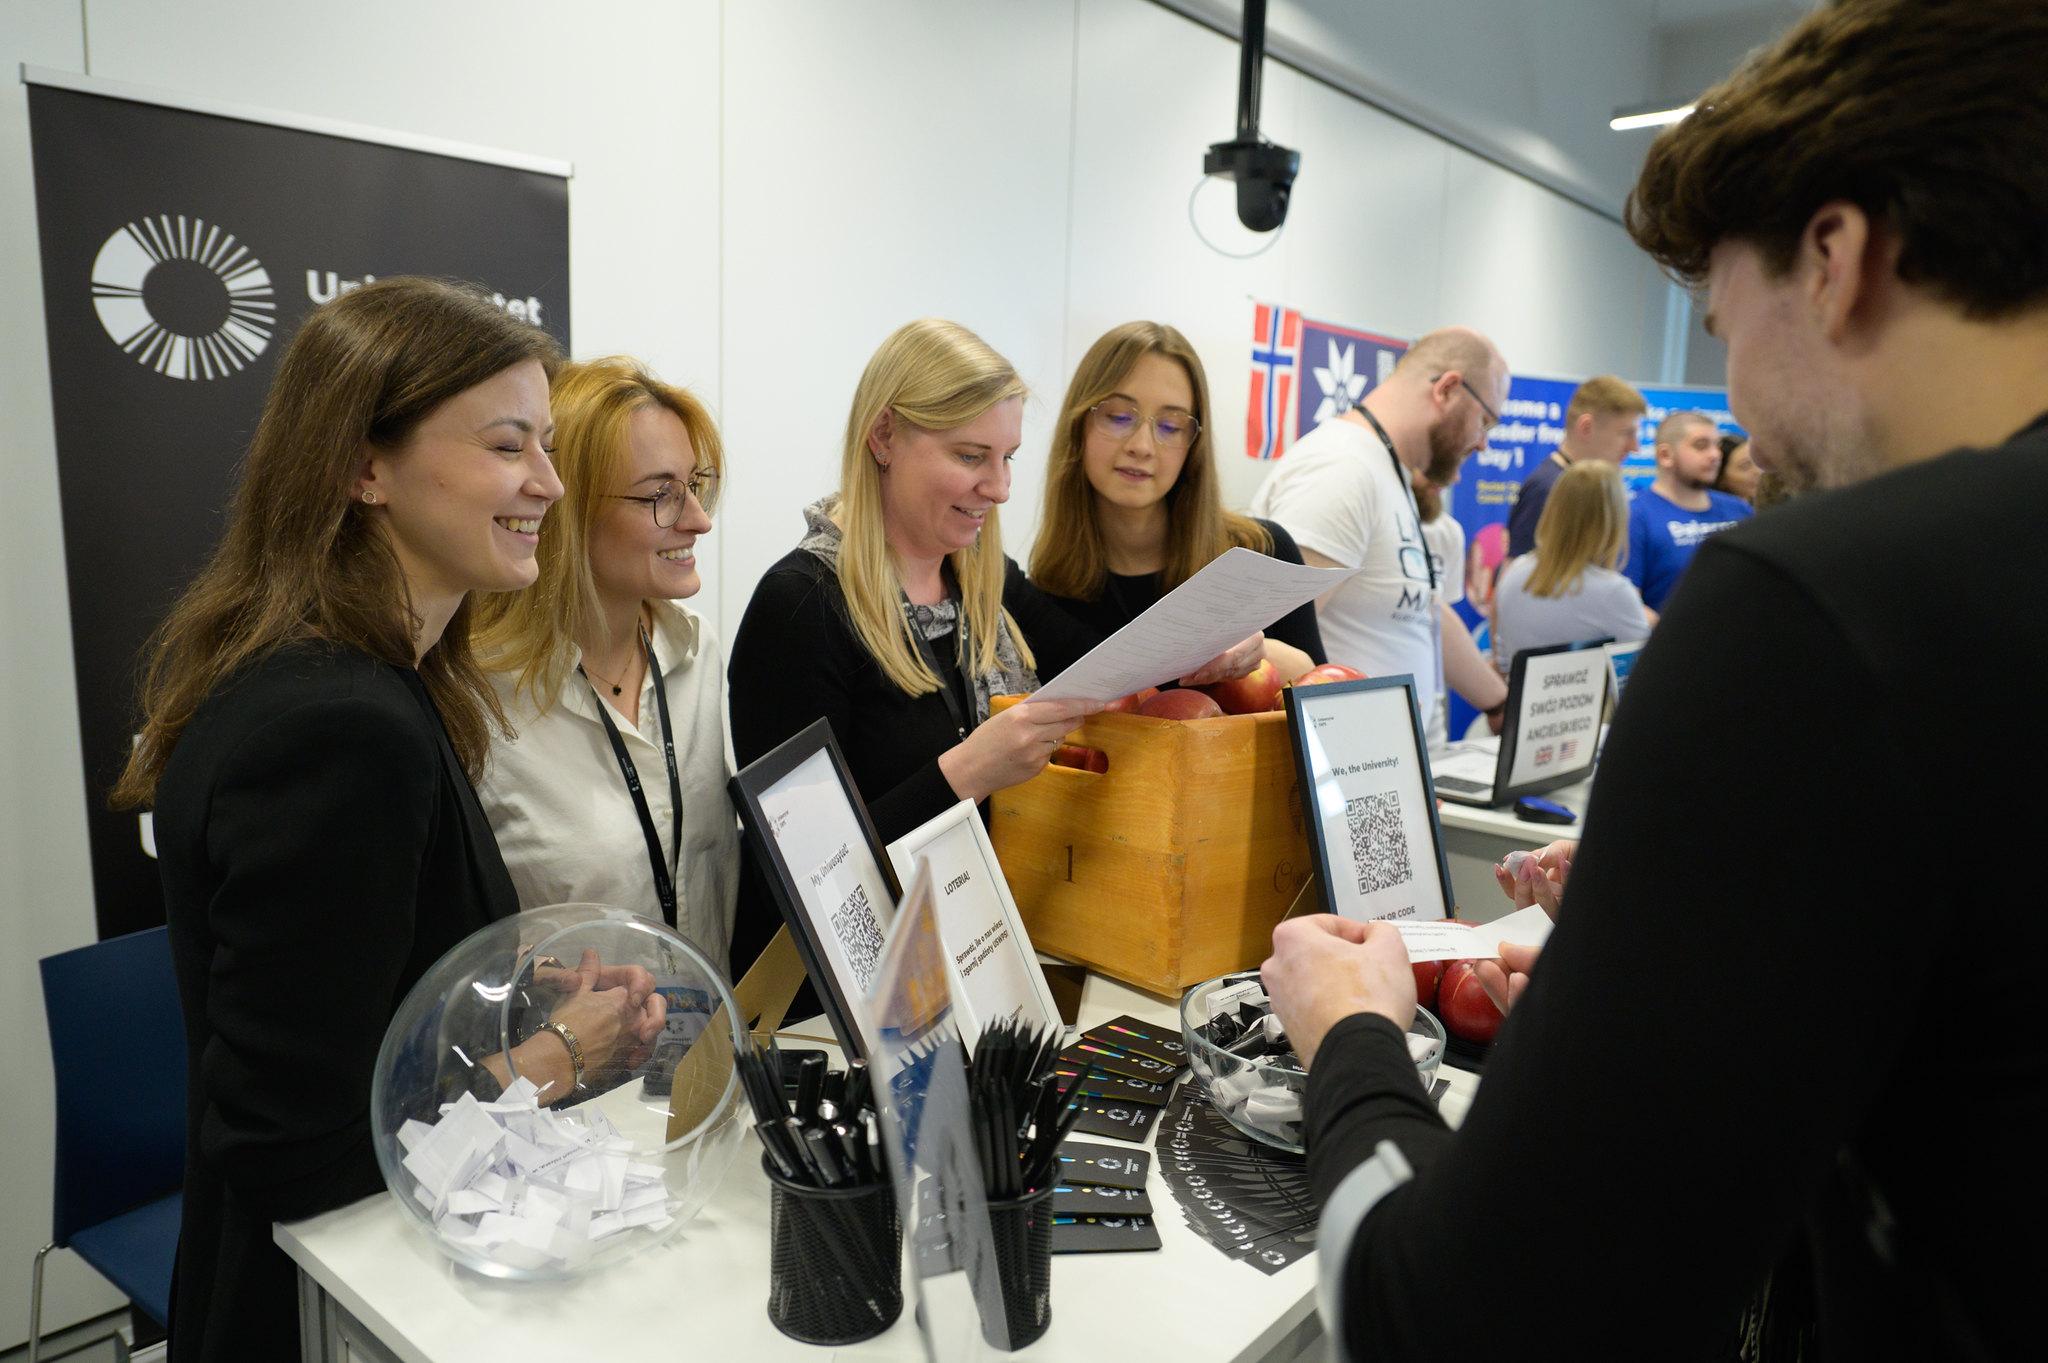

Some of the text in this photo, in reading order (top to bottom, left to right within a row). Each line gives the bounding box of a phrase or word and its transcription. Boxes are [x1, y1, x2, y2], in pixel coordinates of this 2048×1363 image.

[1331, 757, 1400, 777] We, the University!
[944, 870, 971, 896] LOTERIA!
[1397, 905, 1416, 918] CODE
[991, 919, 1004, 934] wiesz
